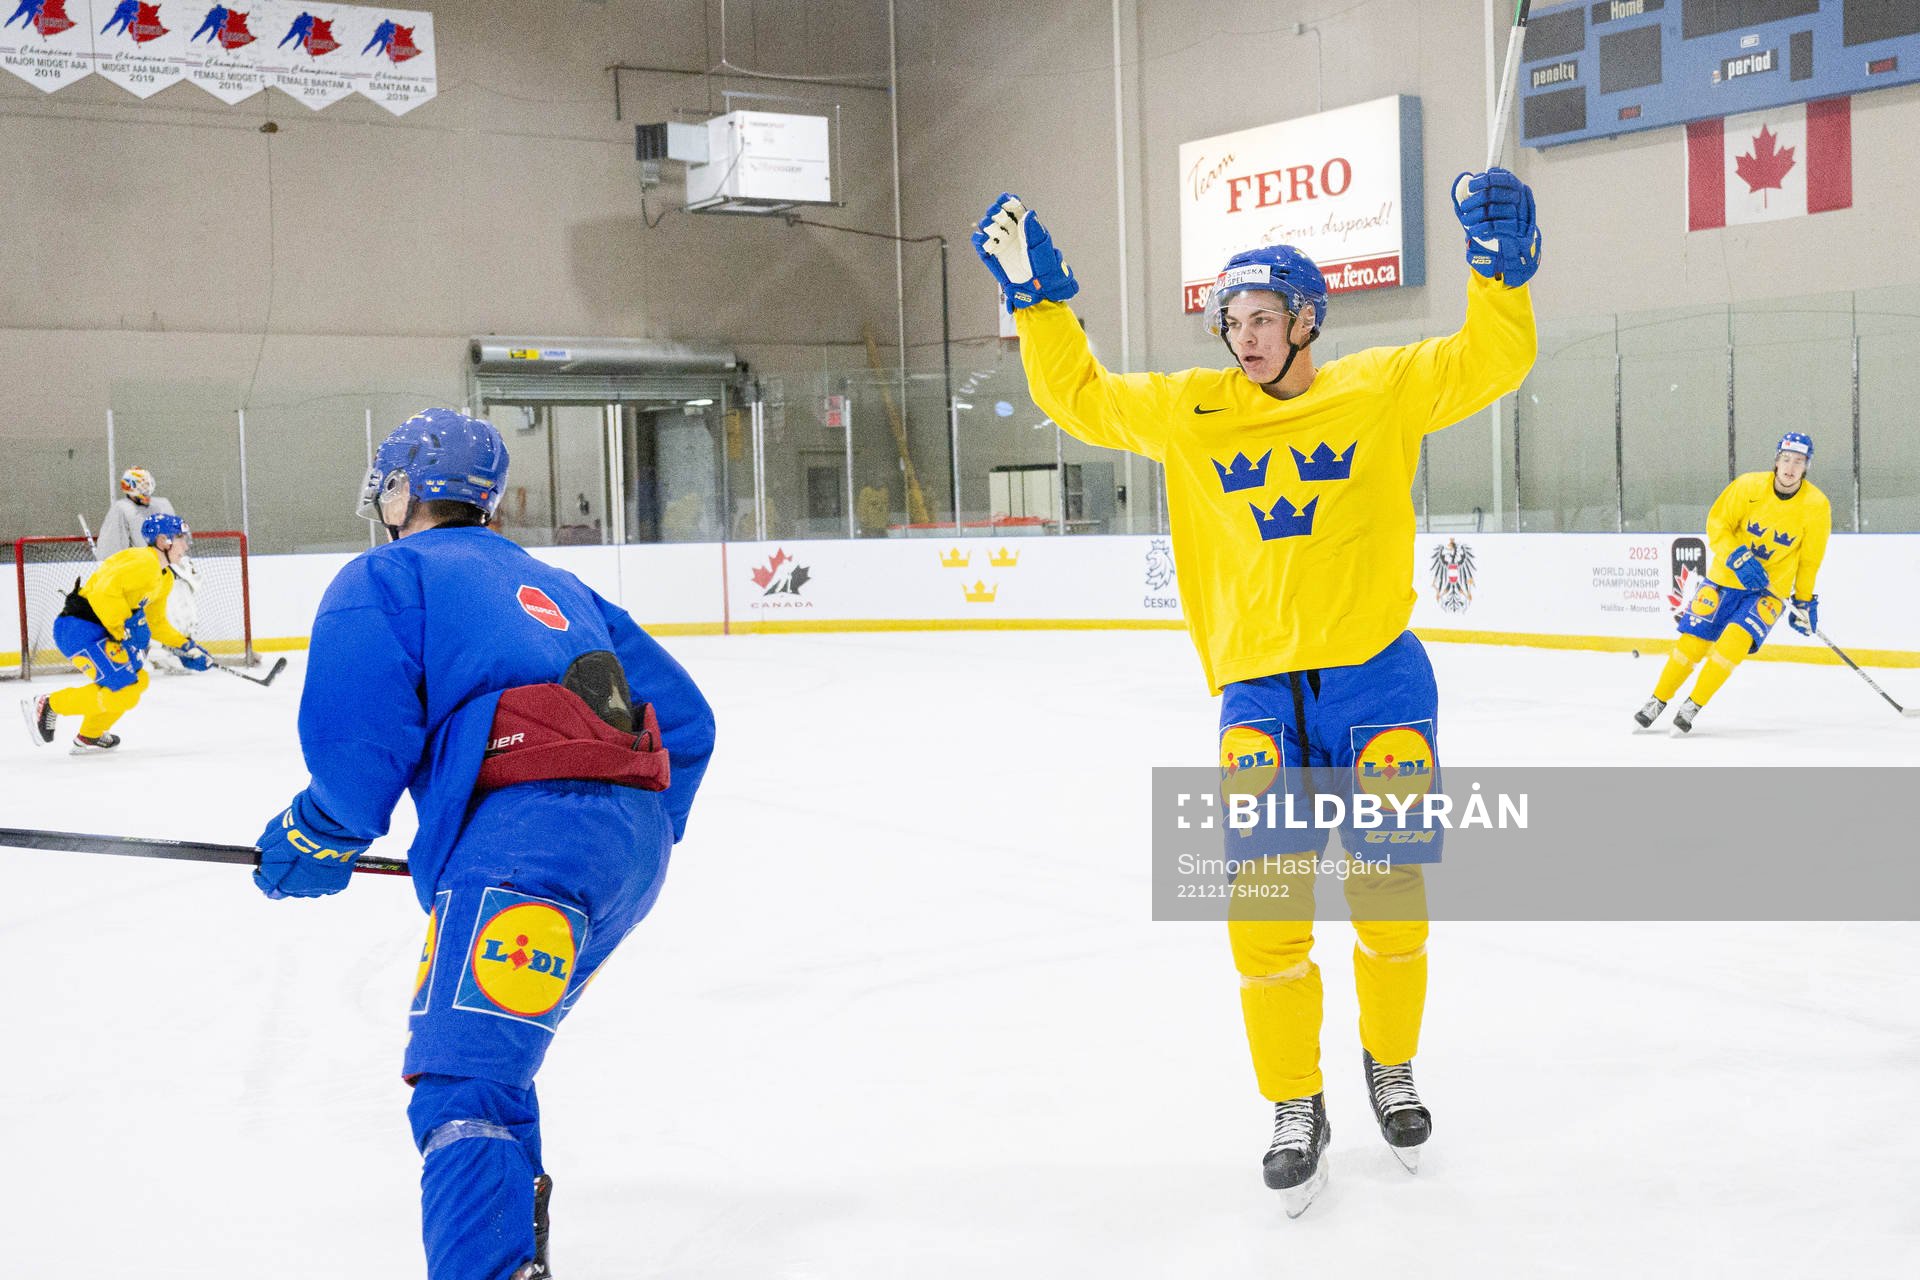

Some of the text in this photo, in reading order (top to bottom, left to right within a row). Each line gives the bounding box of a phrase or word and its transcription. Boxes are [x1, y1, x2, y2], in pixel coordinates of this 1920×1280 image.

[1611, 0, 1644, 20] Home
[20, 45, 73, 58] Champions
[115, 51, 166, 62] Champions
[5, 56, 88, 69] MAJOR MIDGET AAA
[102, 63, 180, 75] MIDGET AAA MAJEUR
[205, 59, 253, 70] Champions
[1728, 50, 1771, 80] period
[35, 68, 61, 78] 2018
[193, 71, 225, 80] FEMALE
[228, 73, 257, 81] MIDGET
[291, 64, 339, 75] Champions
[1533, 63, 1575, 88] penalty
[129, 74, 155, 83] 2019
[277, 75, 309, 86] FEMALE
[311, 78, 344, 88] BANTAM
[369, 83, 427, 93] BANTAM AA
[1187, 151, 1236, 201] Team
[1226, 157, 1353, 214] FERO
[1322, 201, 1392, 243] disposal!
[1629, 547, 1658, 560] 2023
[1675, 547, 1702, 561] IIHF
[1592, 567, 1659, 577] WORLD JUNIOR
[1592, 579, 1660, 588] CHAMPIONSHIP
[1144, 595, 1177, 608] ČESKO
[1623, 590, 1660, 600] CANADA
[1600, 603, 1624, 612] Halifax
[1630, 604, 1660, 613] Moncton
[486, 733, 525, 750] UER
[1364, 830, 1437, 843] CCM
